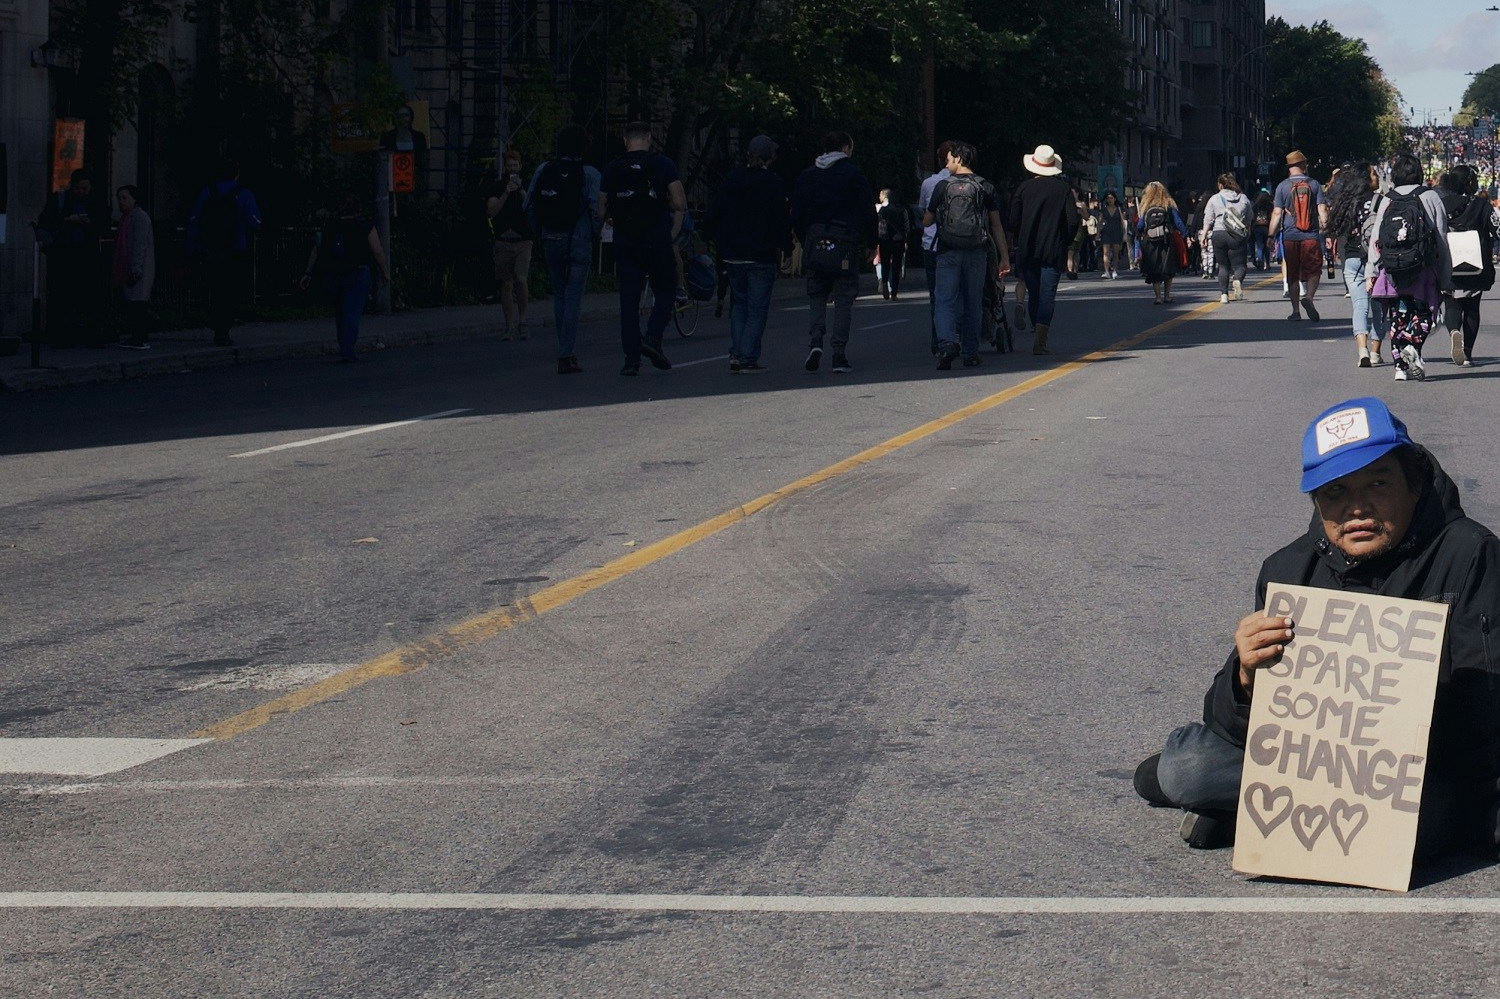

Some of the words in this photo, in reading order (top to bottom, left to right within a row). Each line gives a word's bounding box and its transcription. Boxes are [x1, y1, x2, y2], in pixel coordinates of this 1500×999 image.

[1266, 591, 1444, 663] PLEASE
[1266, 642, 1403, 706] SPARE
[1268, 684, 1385, 747] SOME
[1249, 723, 1425, 814] CHANGE
